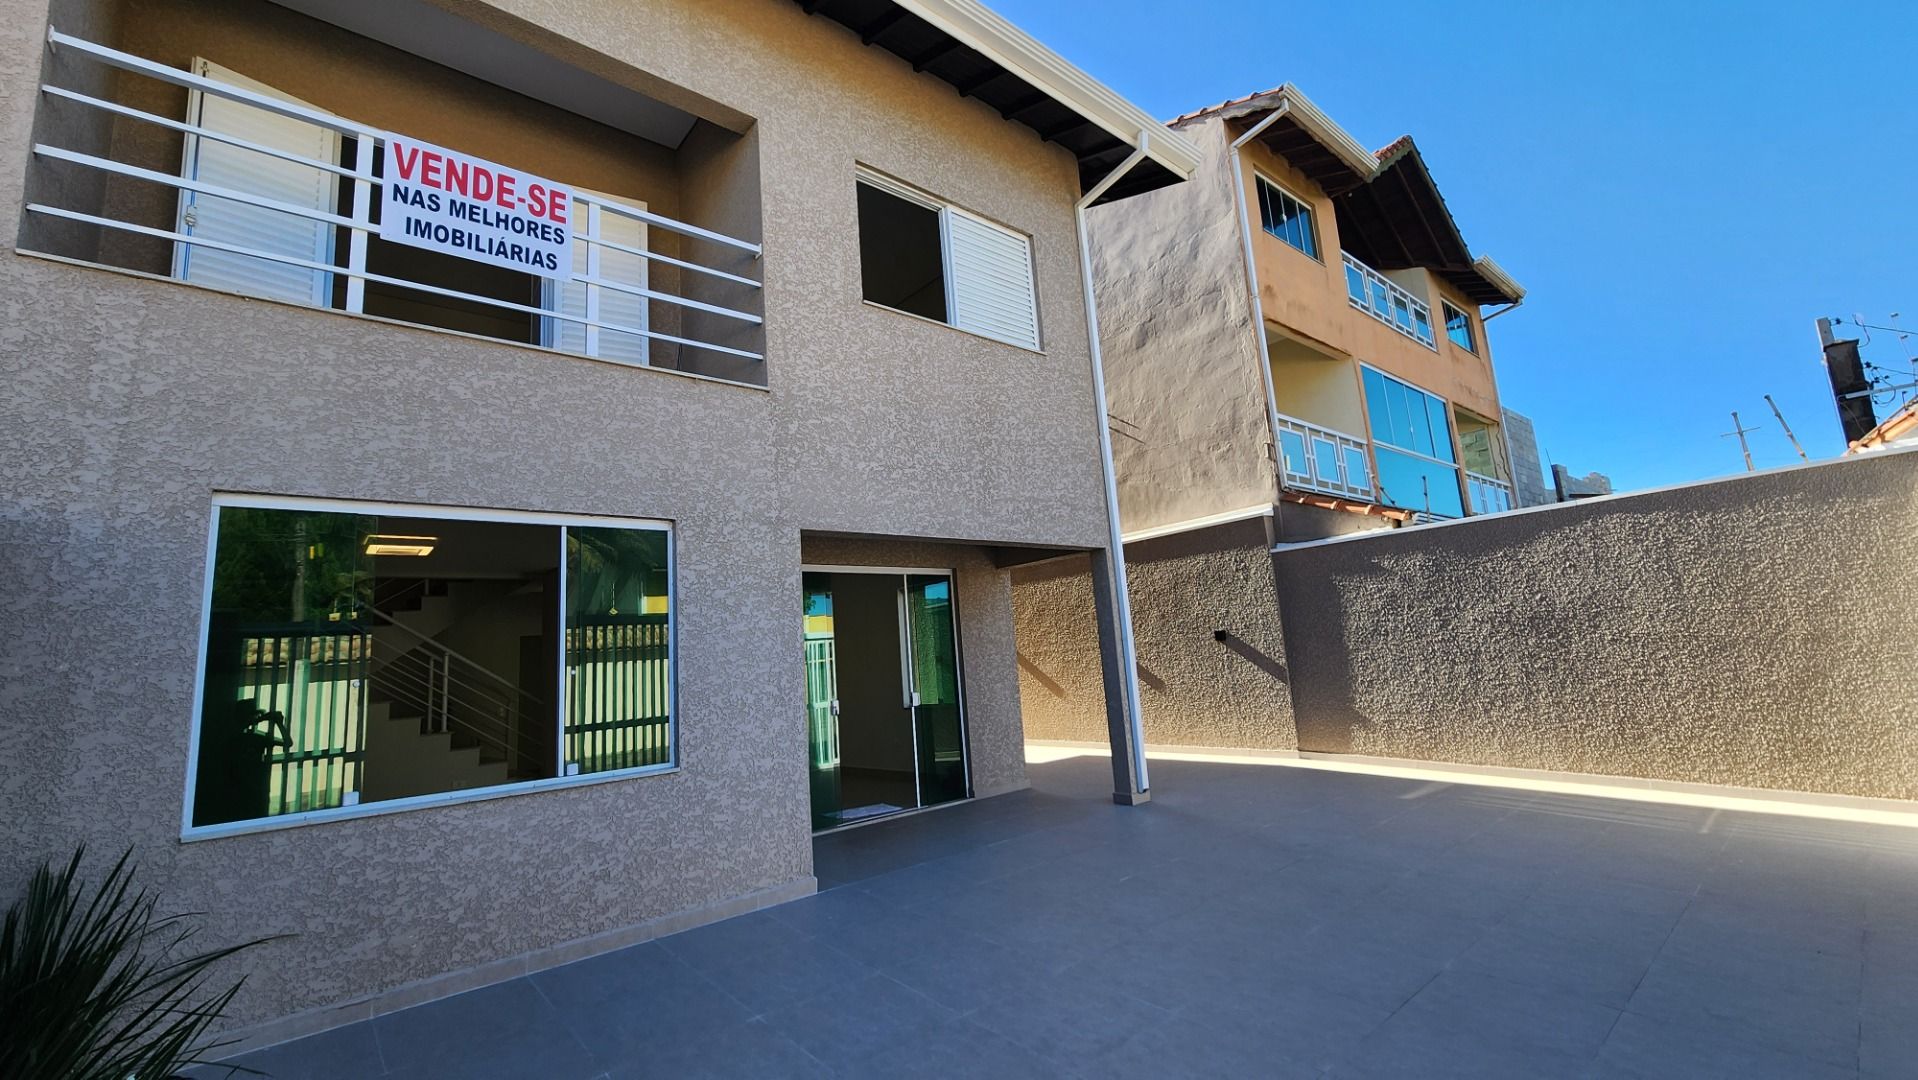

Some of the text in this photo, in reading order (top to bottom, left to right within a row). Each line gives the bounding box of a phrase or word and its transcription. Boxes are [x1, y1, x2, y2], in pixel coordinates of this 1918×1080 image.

[392, 183, 565, 245] NAS MELHORES
[393, 142, 567, 224] VENDE-SE
[405, 216, 558, 270] IMOBILIÁRIAS
